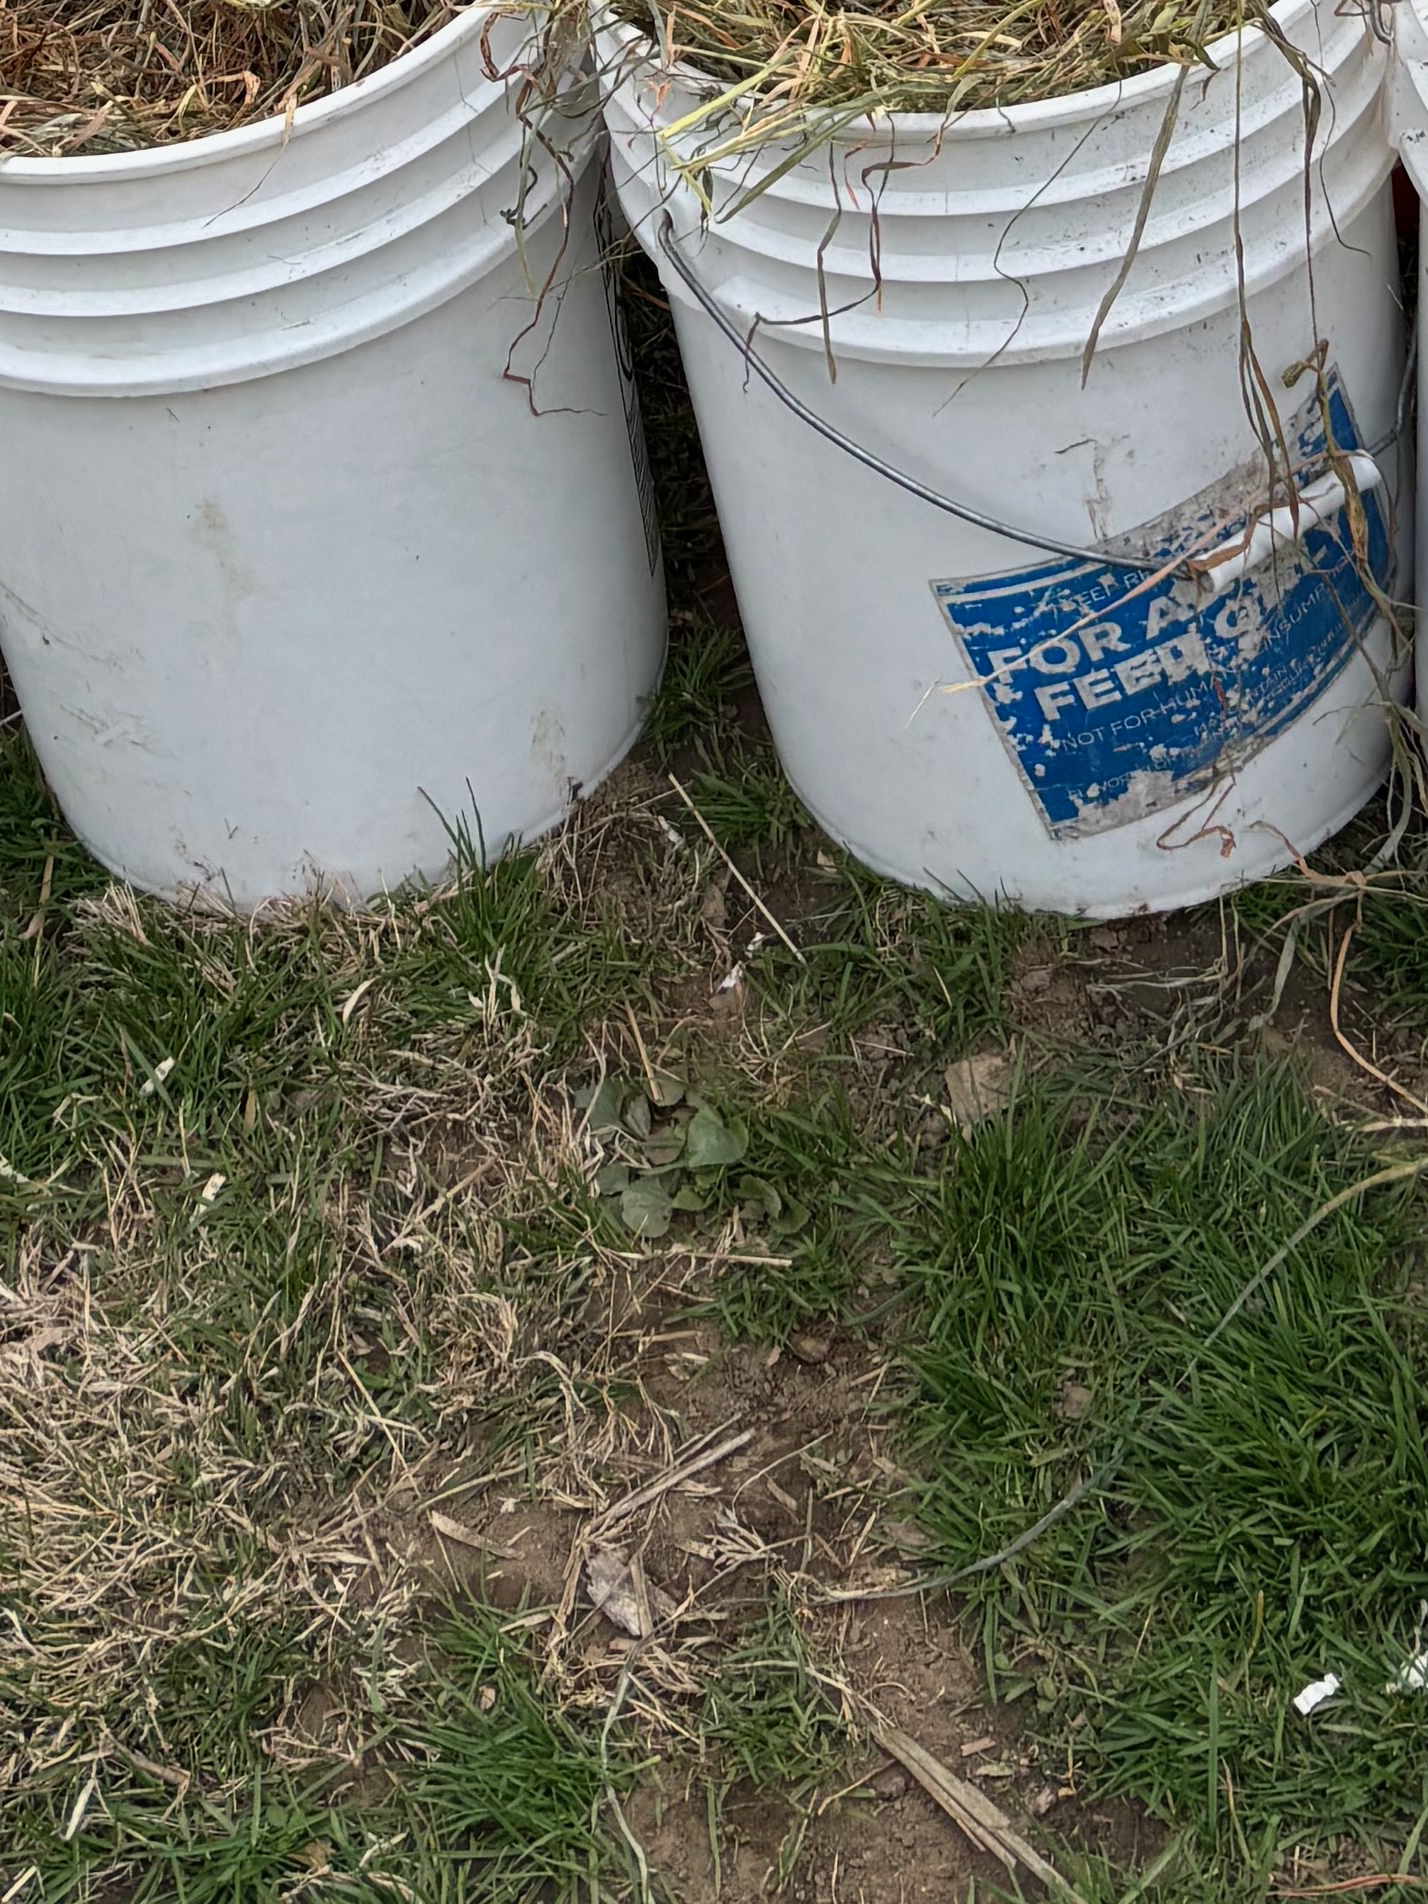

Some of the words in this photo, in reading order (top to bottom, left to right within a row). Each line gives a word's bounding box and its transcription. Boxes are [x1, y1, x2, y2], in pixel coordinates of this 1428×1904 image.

[987, 621, 1127, 684] FOR
[1034, 630, 1210, 720] FEED
[1061, 726, 1107, 751] NOT
[1110, 708, 1157, 735] FOR
